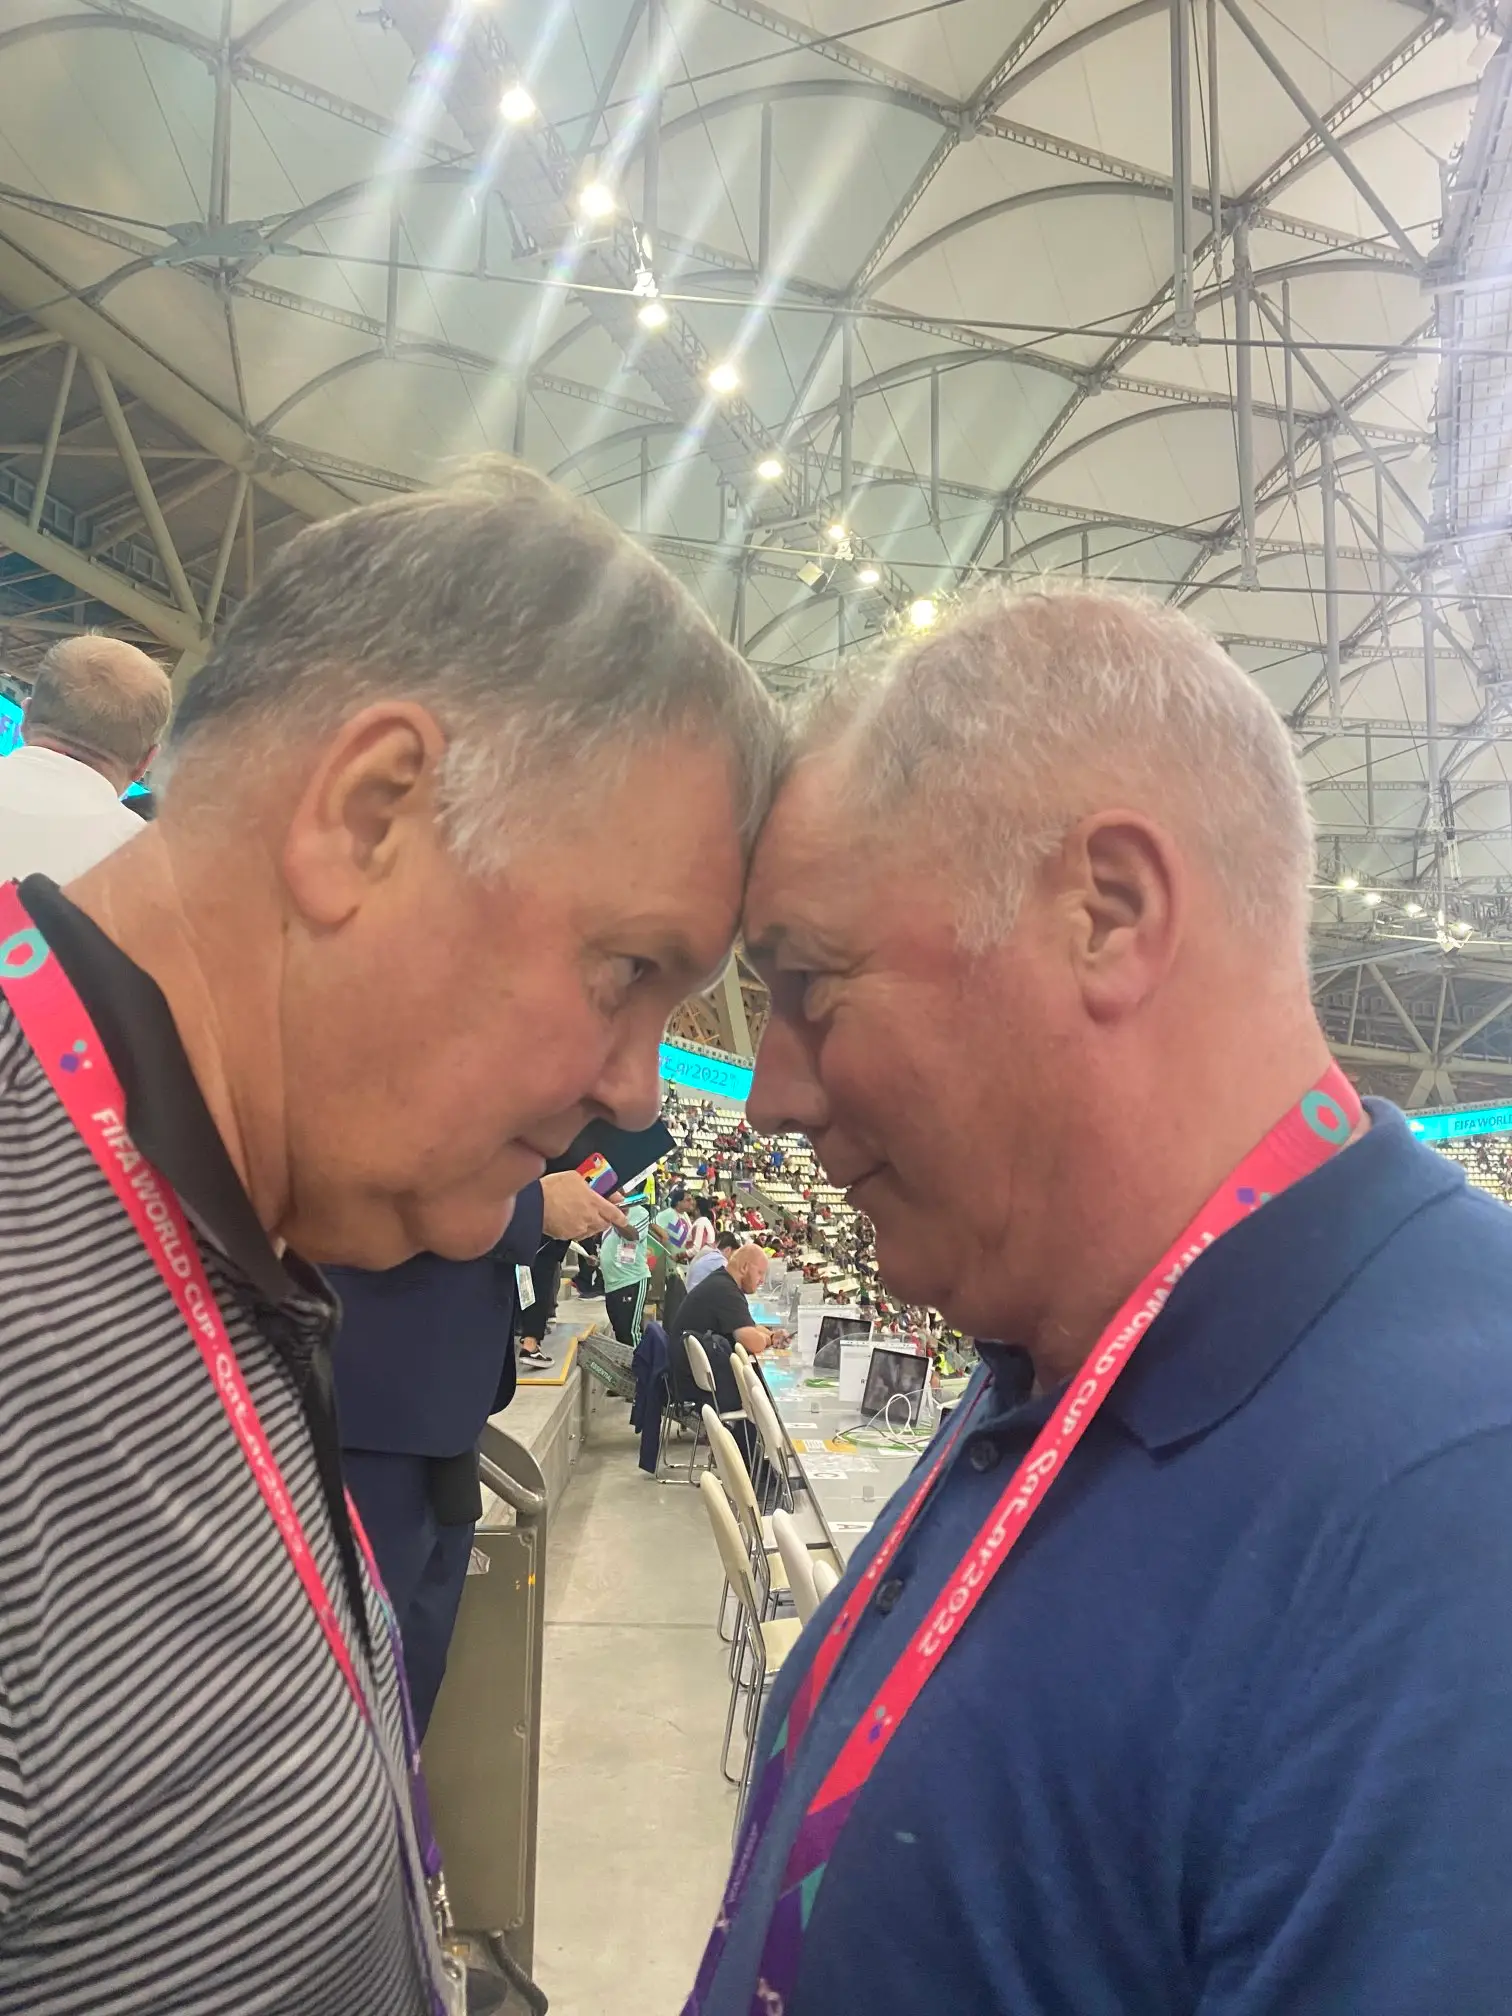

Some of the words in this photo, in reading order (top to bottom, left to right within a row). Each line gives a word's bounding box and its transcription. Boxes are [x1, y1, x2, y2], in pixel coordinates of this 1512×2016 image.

[1454, 1119, 1476, 1131] FIFA
[91, 1108, 141, 1173] FIFA
[131, 1170, 192, 1278] WORLD
[184, 1281, 216, 1340] CUP
[1094, 1287, 1170, 1375] WORLD
[1061, 1379, 1098, 1436] CUP
